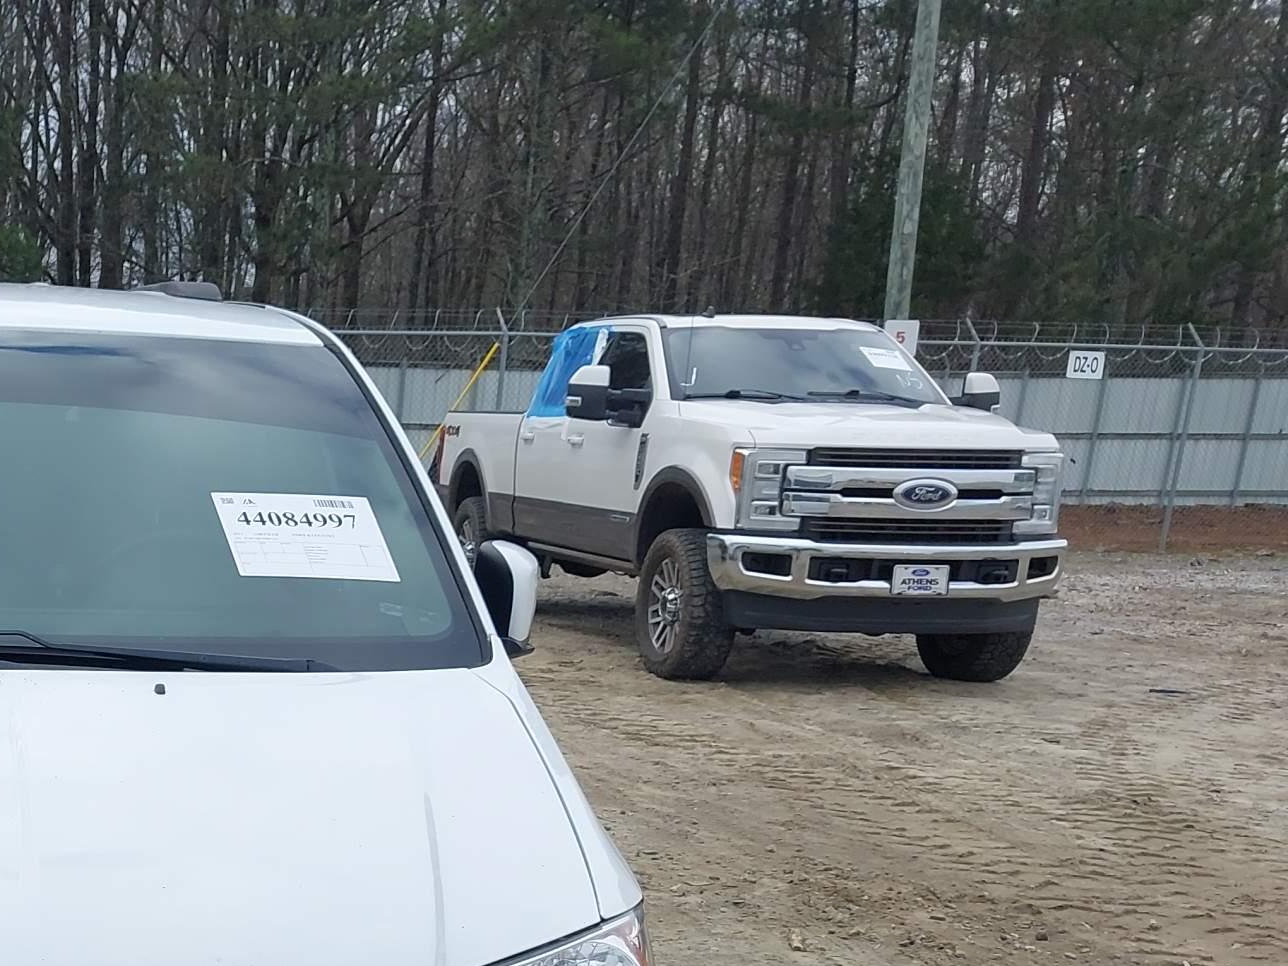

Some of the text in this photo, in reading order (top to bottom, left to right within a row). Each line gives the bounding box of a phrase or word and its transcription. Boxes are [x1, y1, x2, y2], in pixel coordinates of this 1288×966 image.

[895, 331, 906, 344] 5
[912, 486, 943, 501] Ford
[237, 511, 356, 529] 44084997
[900, 578, 939, 586] ATHENS
